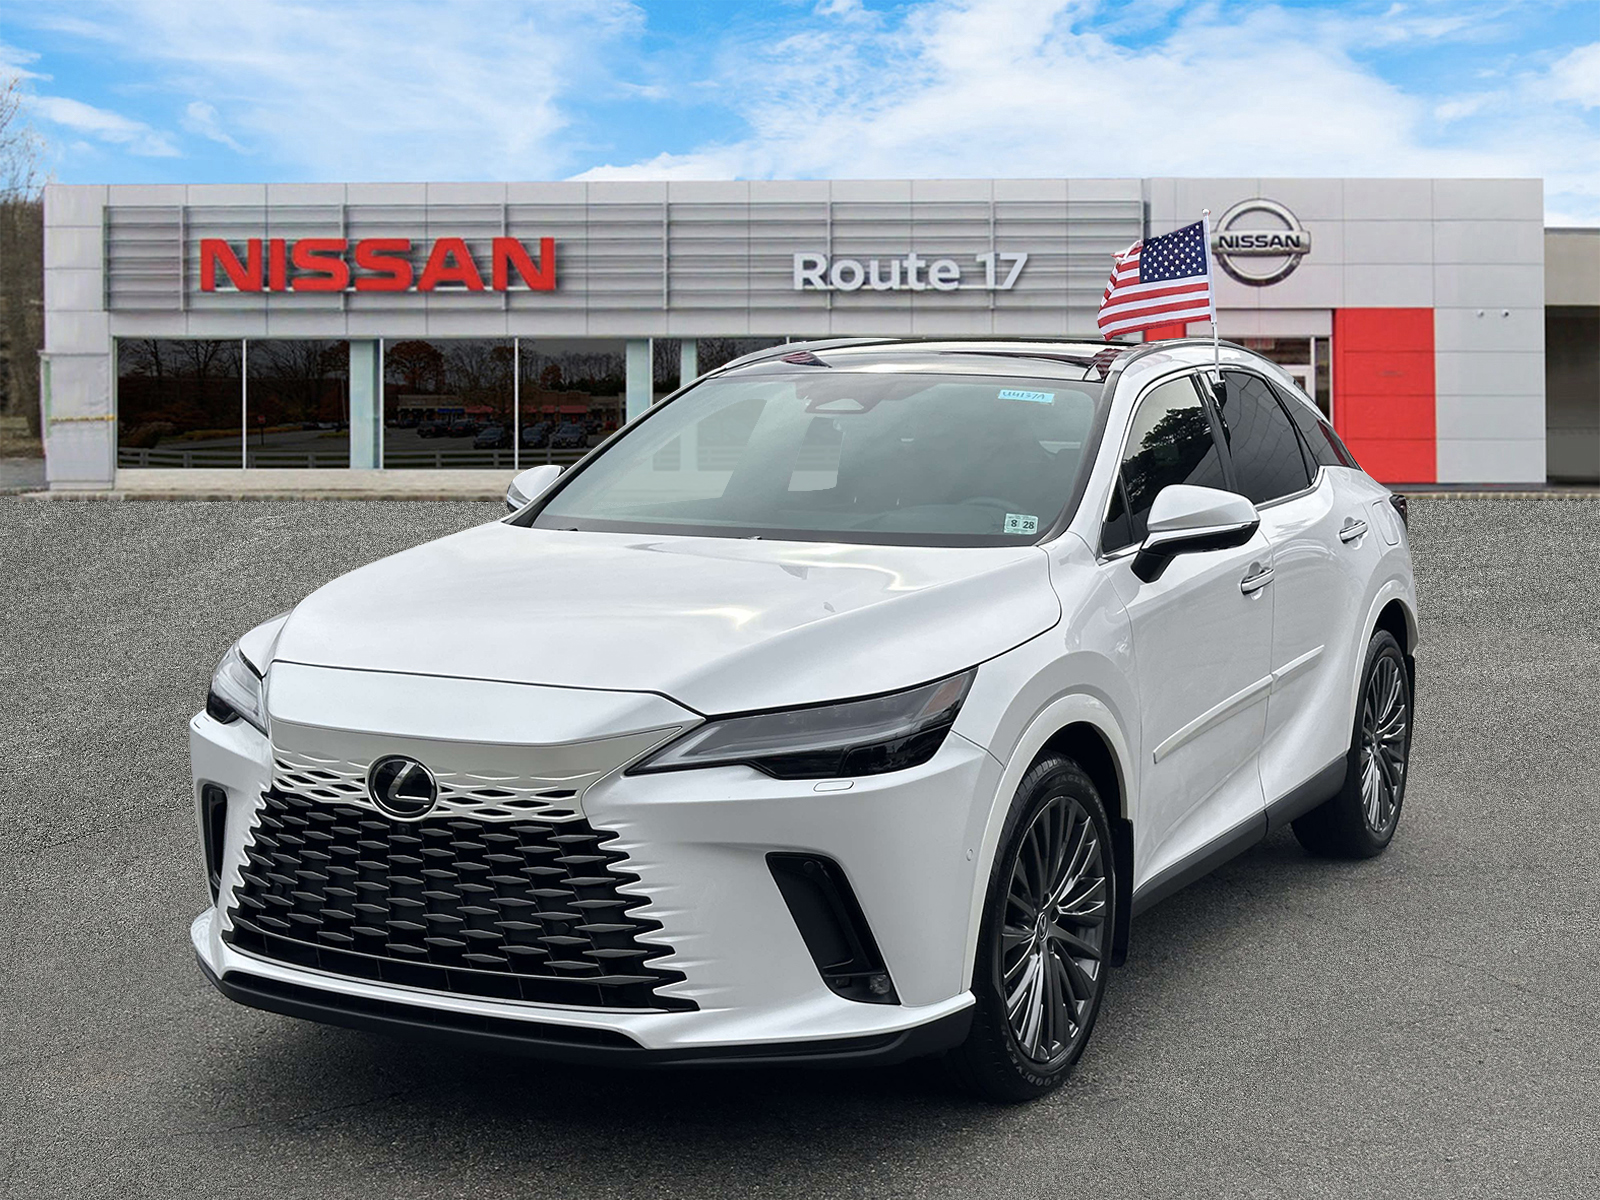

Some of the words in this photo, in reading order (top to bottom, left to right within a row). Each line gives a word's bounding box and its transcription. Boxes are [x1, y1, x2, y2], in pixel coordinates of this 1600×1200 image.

[1218, 234, 1300, 248] NISSAN
[200, 237, 556, 291] NISSAN
[793, 252, 961, 291] Route
[975, 252, 1029, 290] 17
[1010, 519, 1018, 527] 8
[1022, 520, 1035, 529] 28
